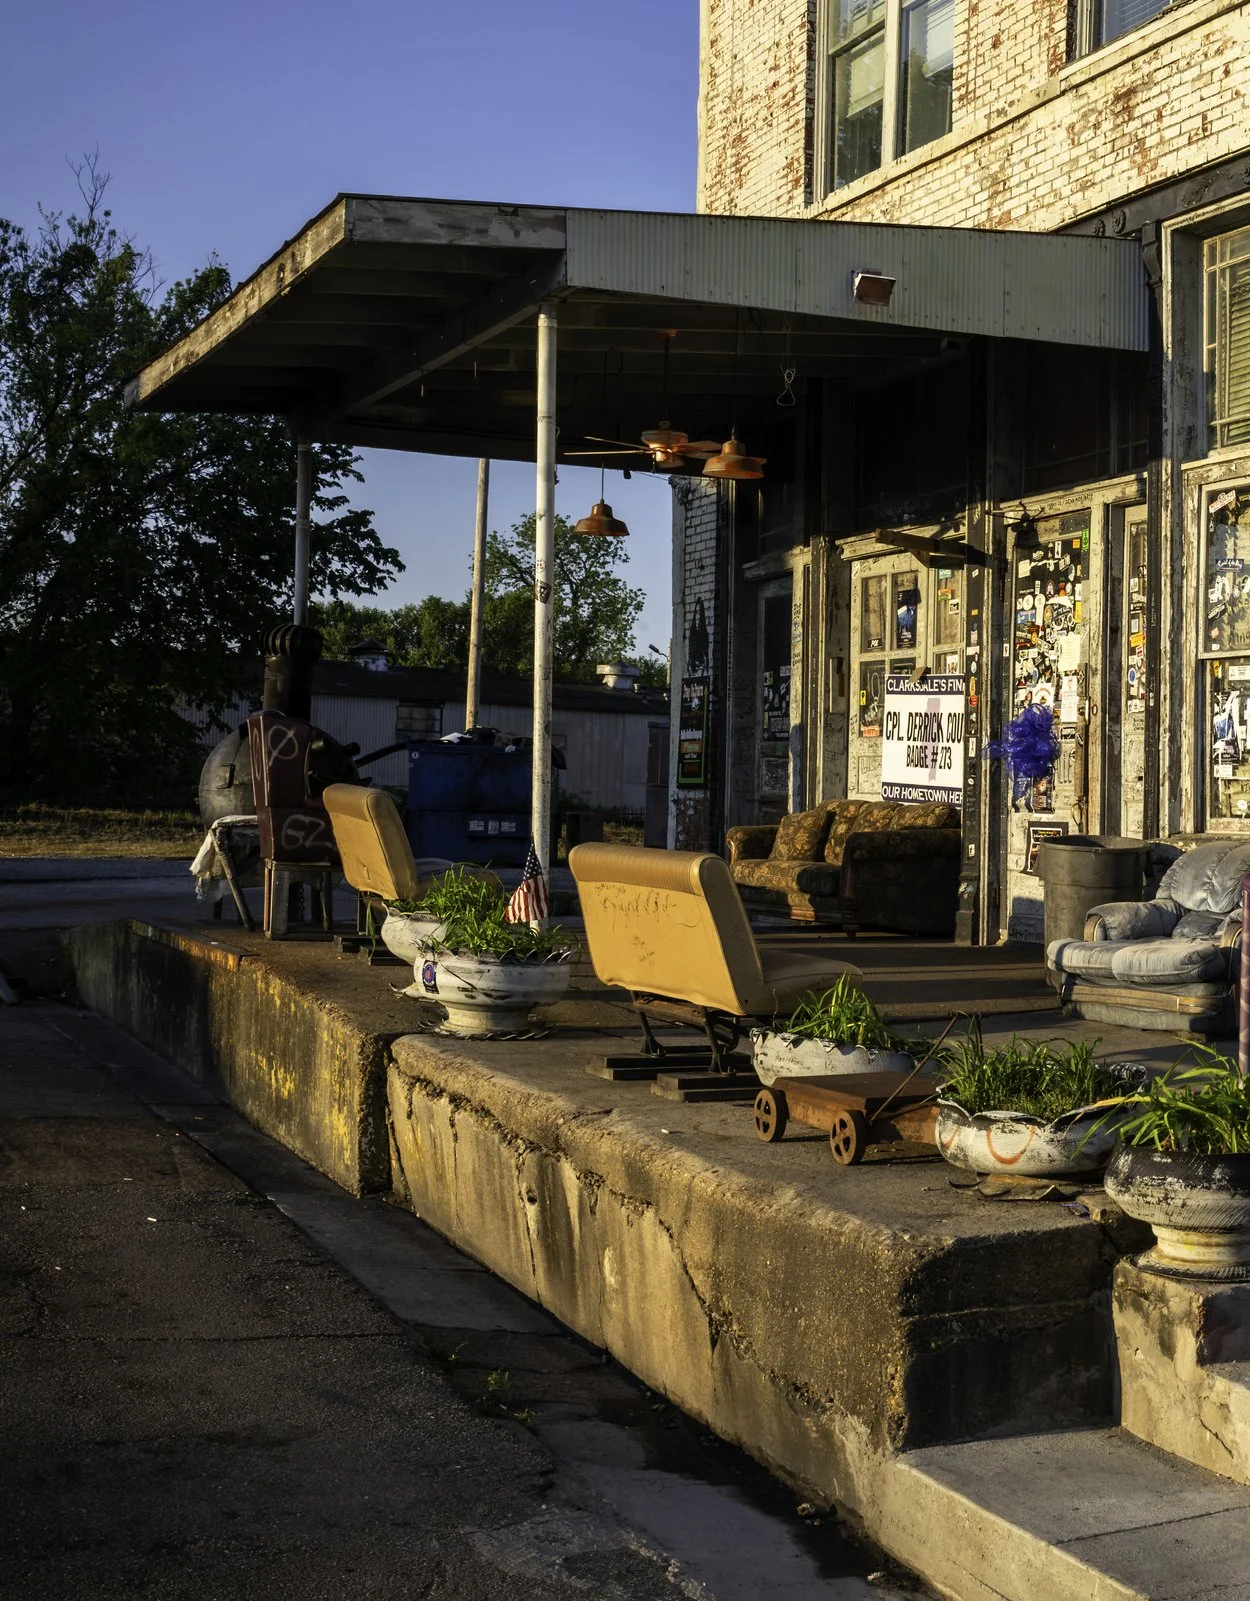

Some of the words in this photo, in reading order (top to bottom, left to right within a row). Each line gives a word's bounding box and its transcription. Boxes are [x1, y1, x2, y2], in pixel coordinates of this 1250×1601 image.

[886, 710, 904, 741] CPL.
[906, 711, 945, 743] DERRICK
[906, 745, 929, 769] BADGE
[930, 746, 938, 769] #
[938, 746, 952, 770] 273
[882, 785, 900, 799] OUR
[901, 786, 949, 802] HOMETOWN
